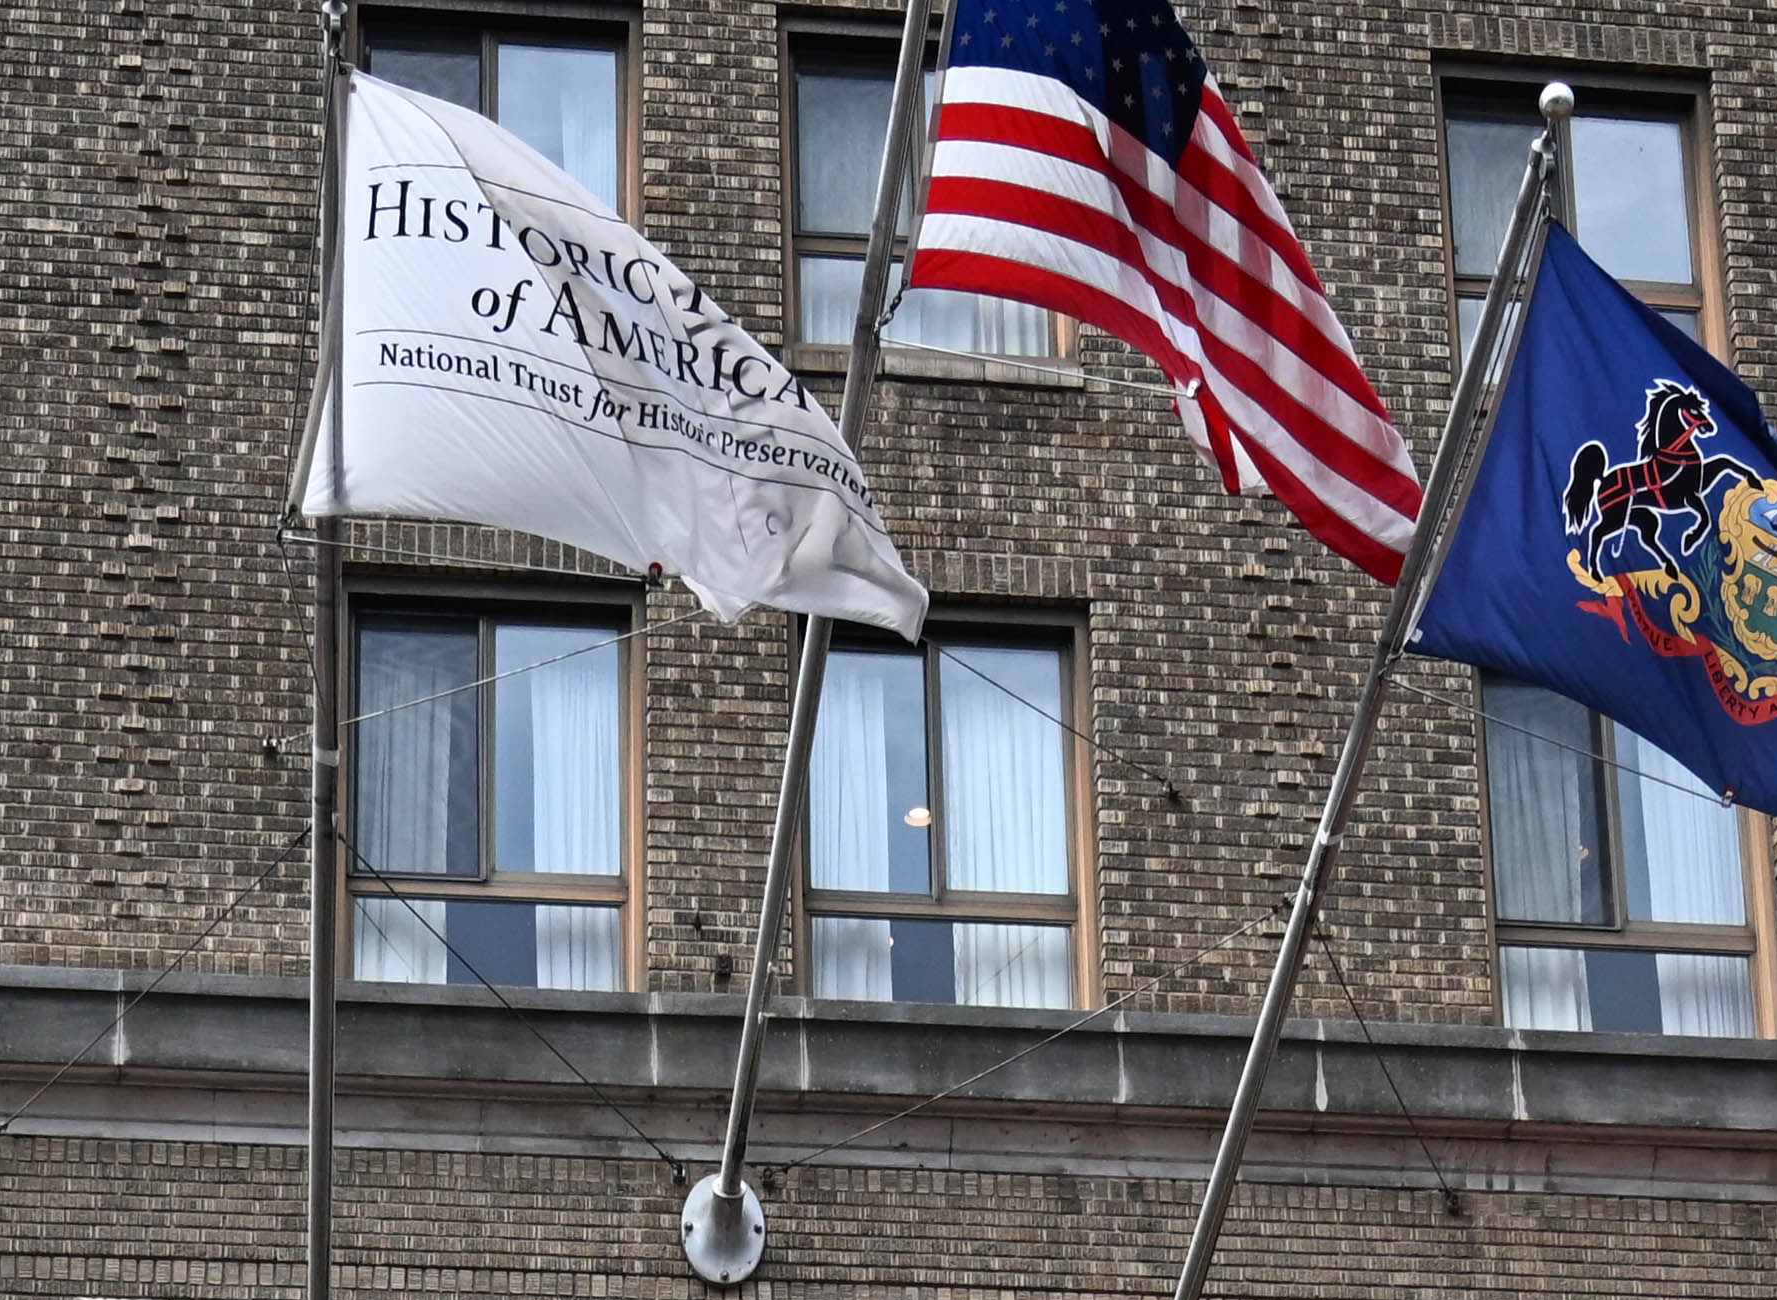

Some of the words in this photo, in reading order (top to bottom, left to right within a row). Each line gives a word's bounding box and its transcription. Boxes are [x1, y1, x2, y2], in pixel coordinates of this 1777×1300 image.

[379, 342, 502, 383] National
[508, 361, 583, 409] Trust
[583, 388, 632, 422] for
[471, 279, 533, 333] of
[539, 280, 812, 412] AMERICA
[1704, 651, 1760, 719] LIBERTY
